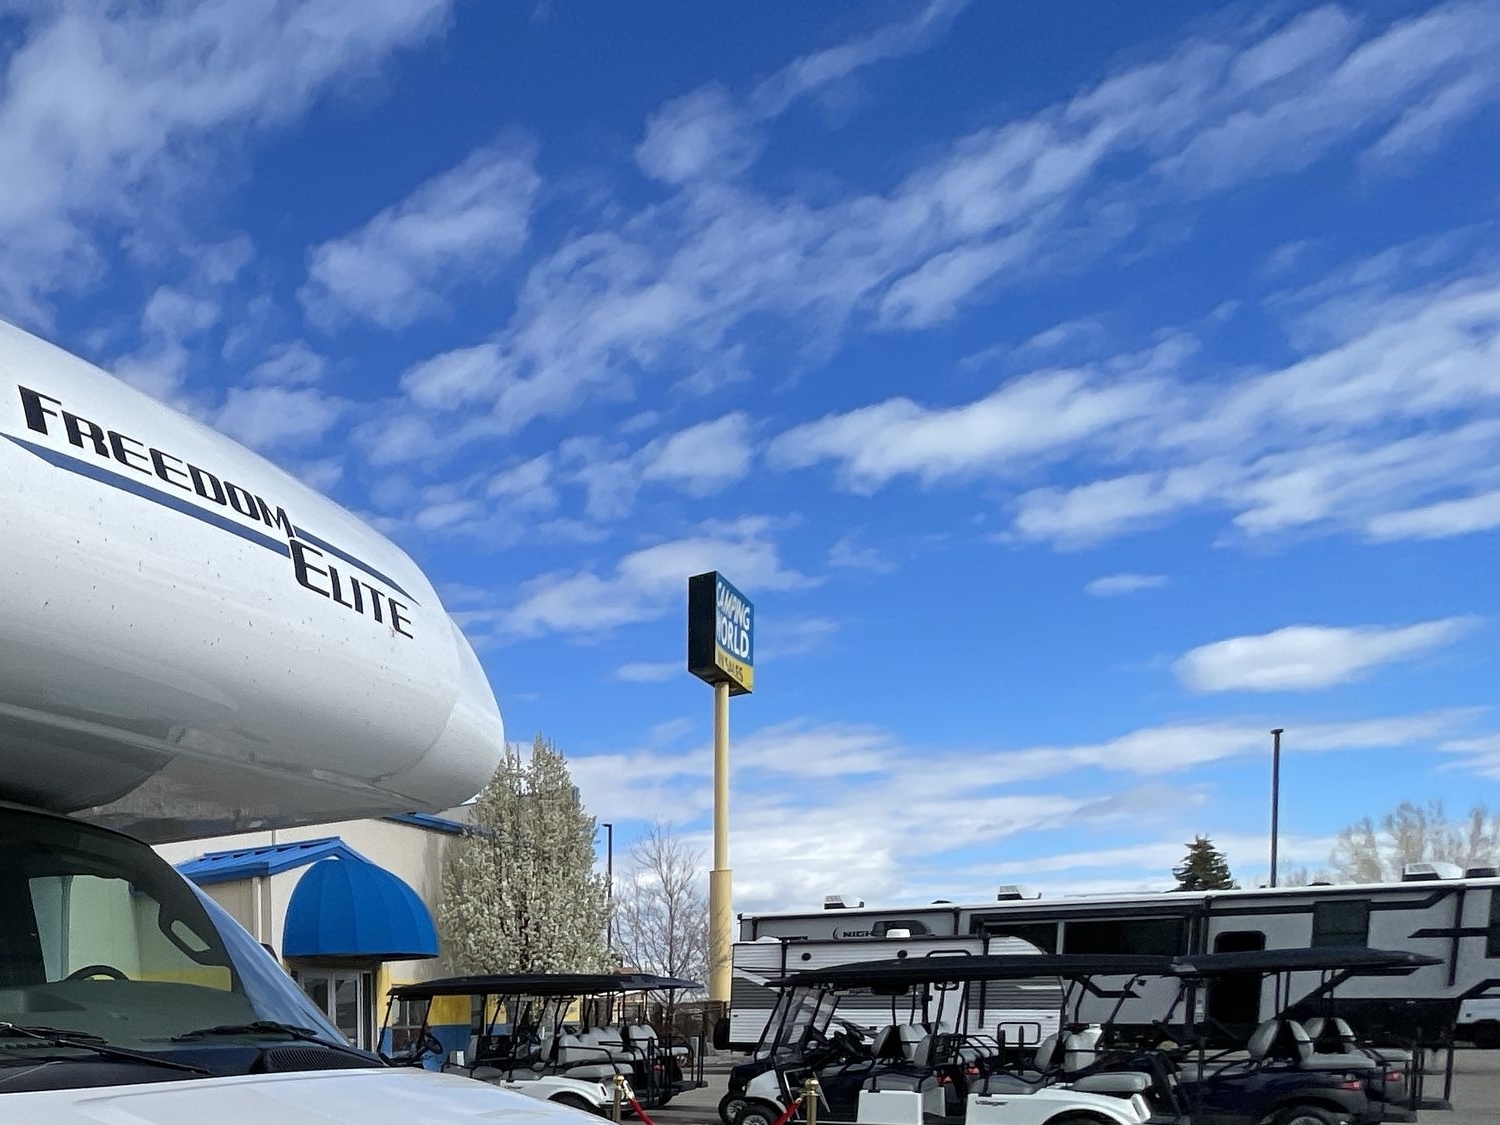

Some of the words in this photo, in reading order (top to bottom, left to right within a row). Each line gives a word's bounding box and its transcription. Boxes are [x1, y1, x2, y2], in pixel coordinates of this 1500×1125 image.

[17, 384, 296, 539] FREEDOM
[290, 538, 414, 640] ELITE
[716, 580, 751, 631] CAMPING
[715, 608, 750, 659] WORLD
[842, 930, 876, 938] NIGH
